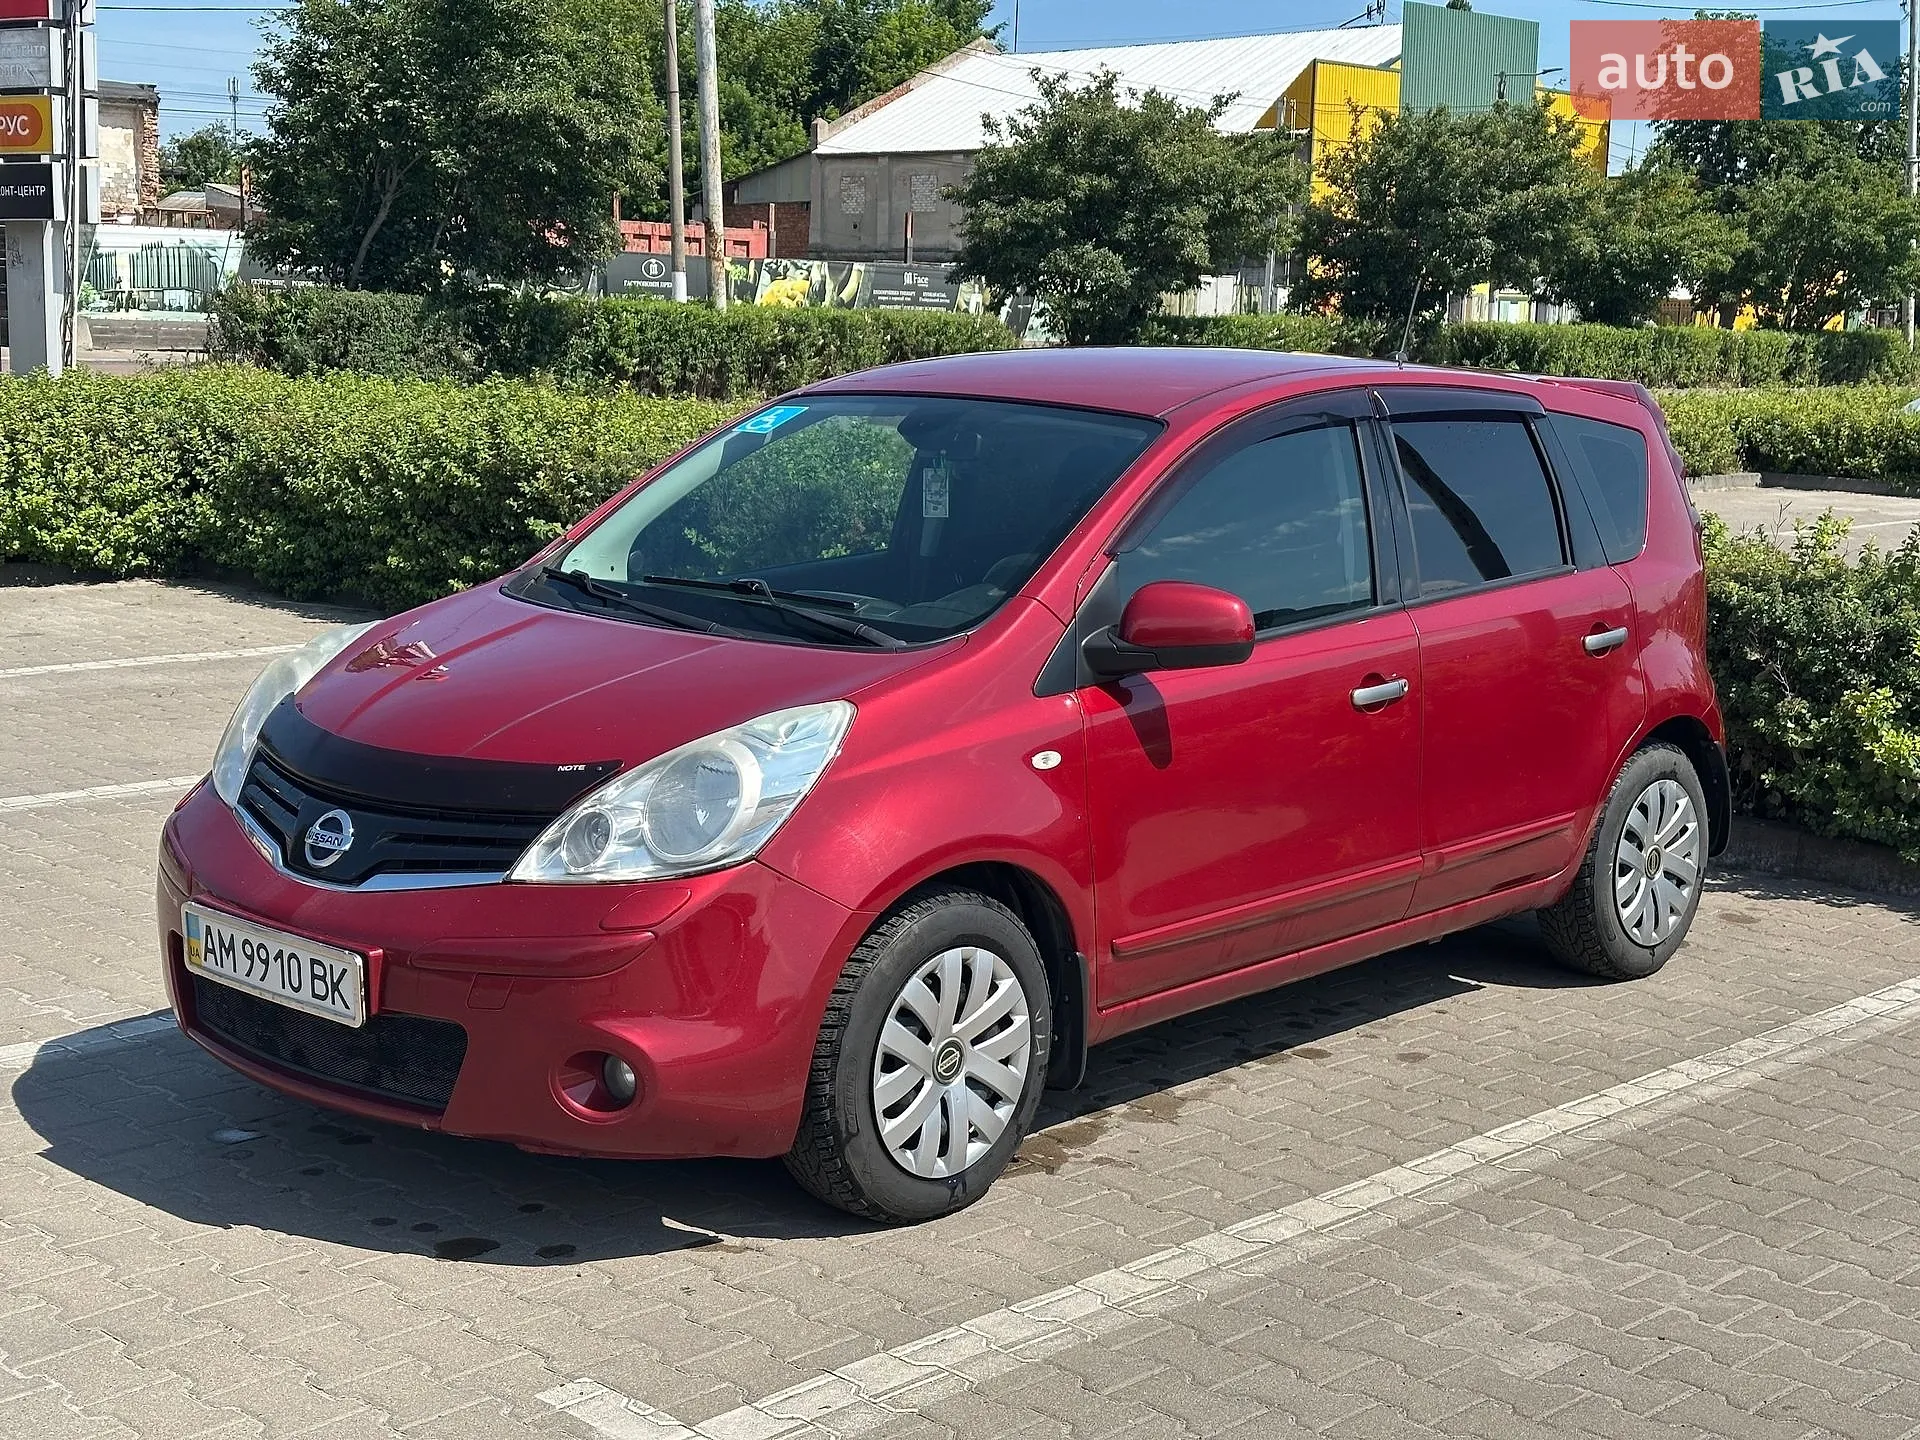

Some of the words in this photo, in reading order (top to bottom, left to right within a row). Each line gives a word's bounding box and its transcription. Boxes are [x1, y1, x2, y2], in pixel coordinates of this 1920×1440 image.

[557, 764, 587, 772] NOTE
[309, 829, 344, 847] NISSAN
[203, 925, 238, 974] AM
[241, 938, 302, 994] 9910
[309, 957, 351, 1010] BK
